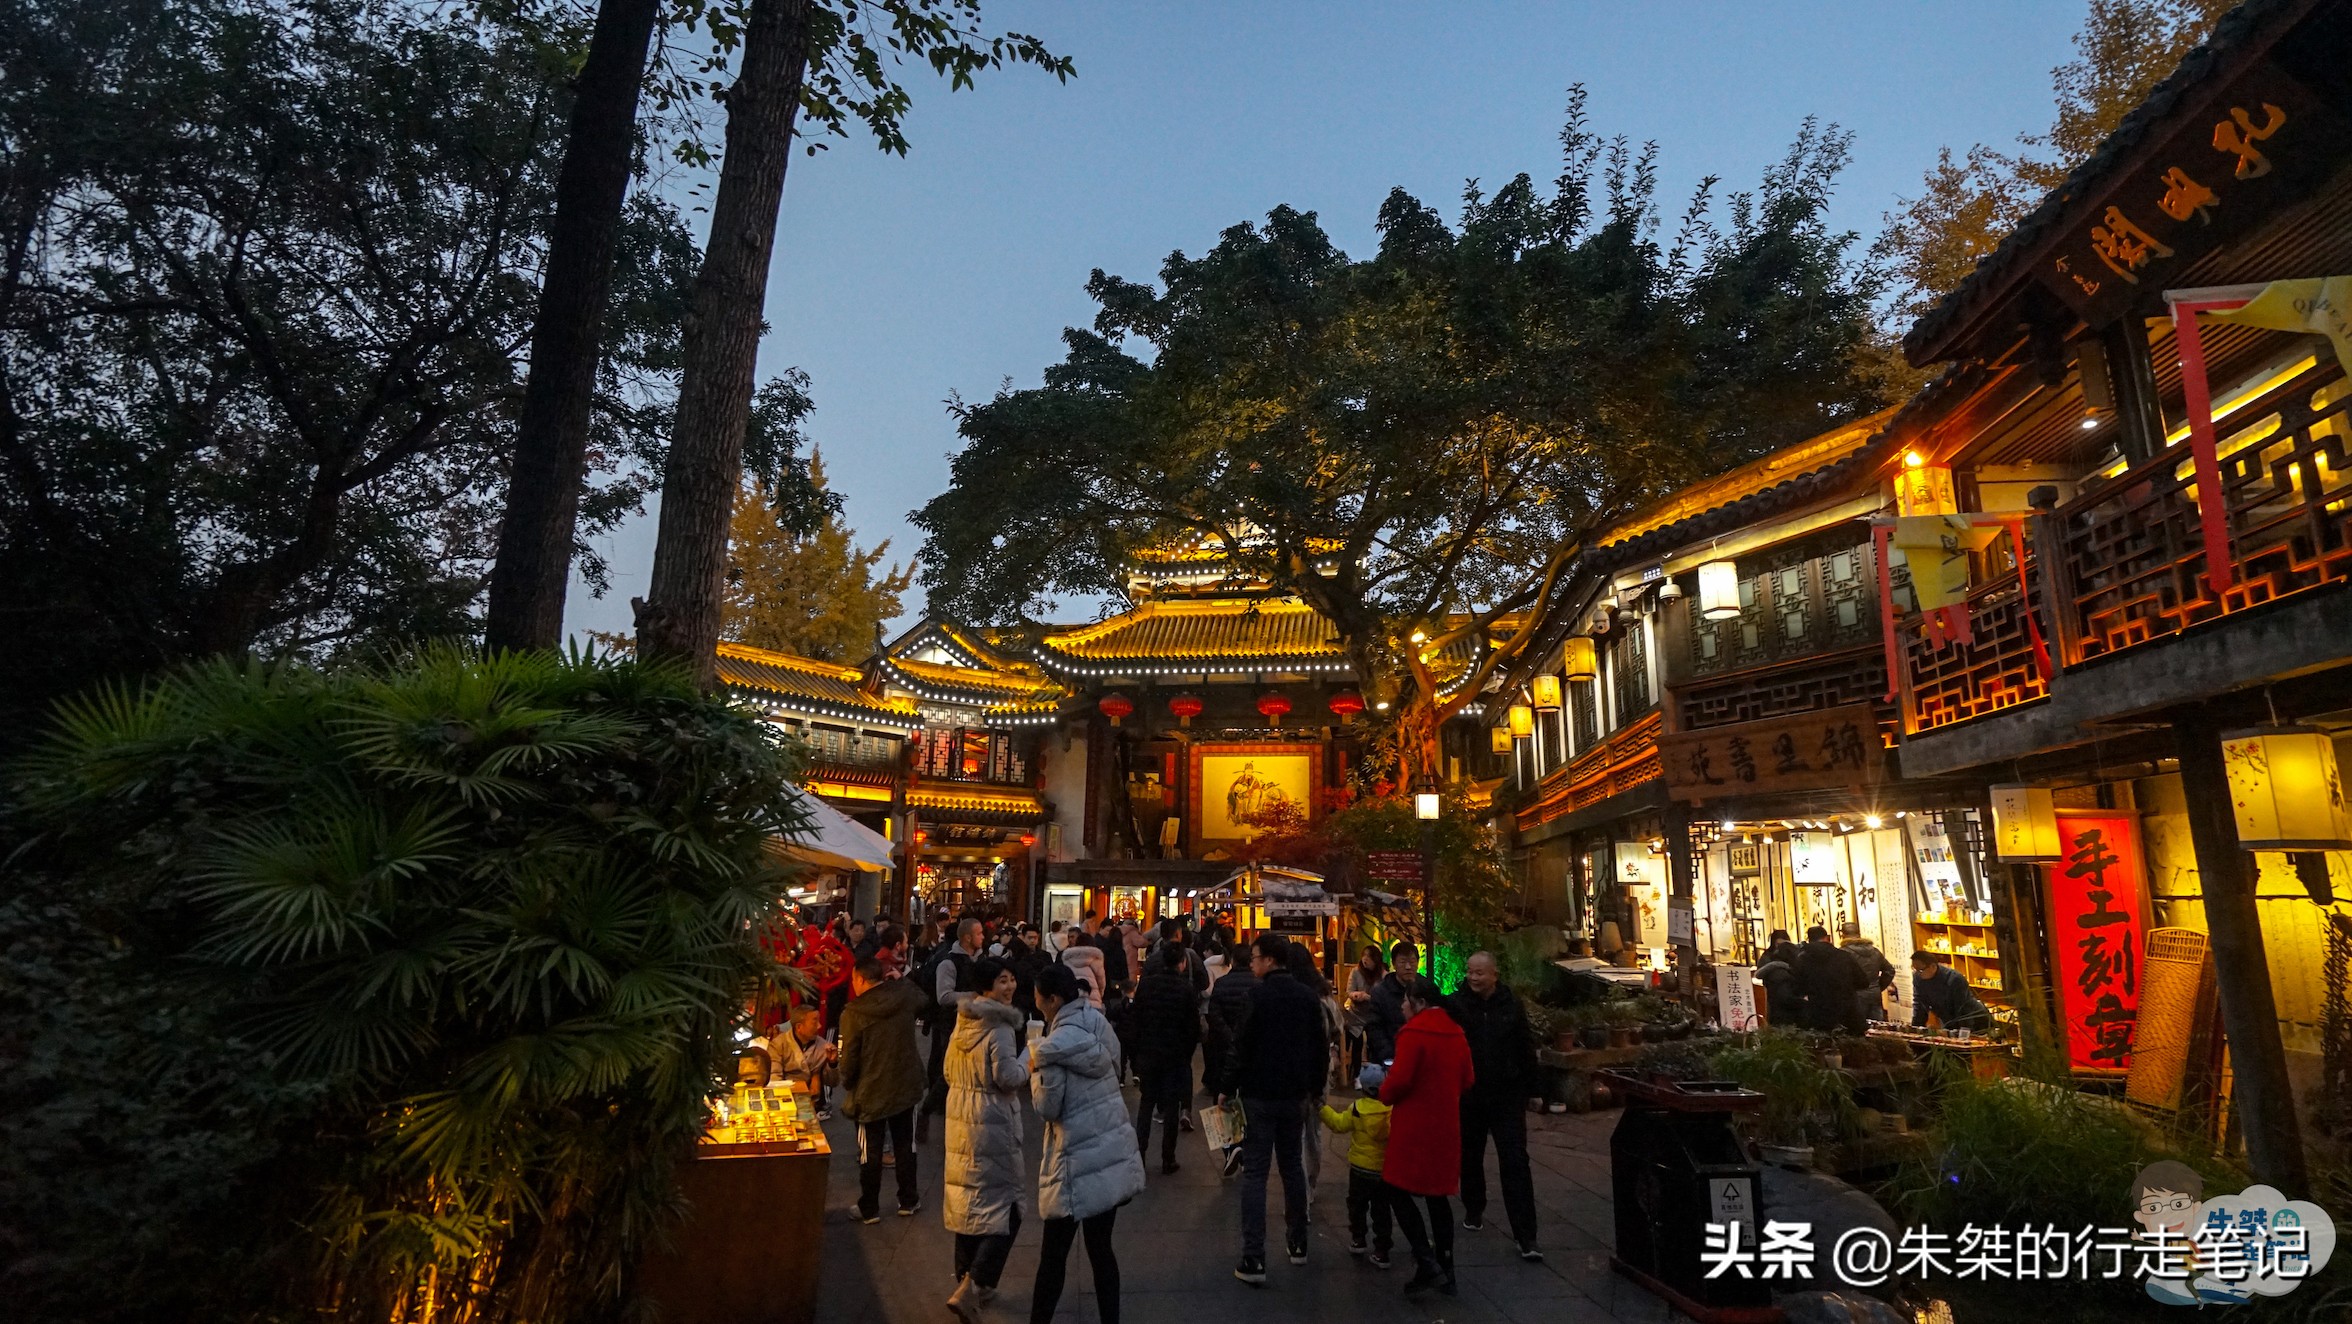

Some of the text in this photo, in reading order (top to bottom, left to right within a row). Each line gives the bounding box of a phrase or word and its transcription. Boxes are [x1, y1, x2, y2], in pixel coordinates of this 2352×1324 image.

[1858, 872, 1875, 910] 和
[2064, 829, 2136, 1067] 手工刻章
